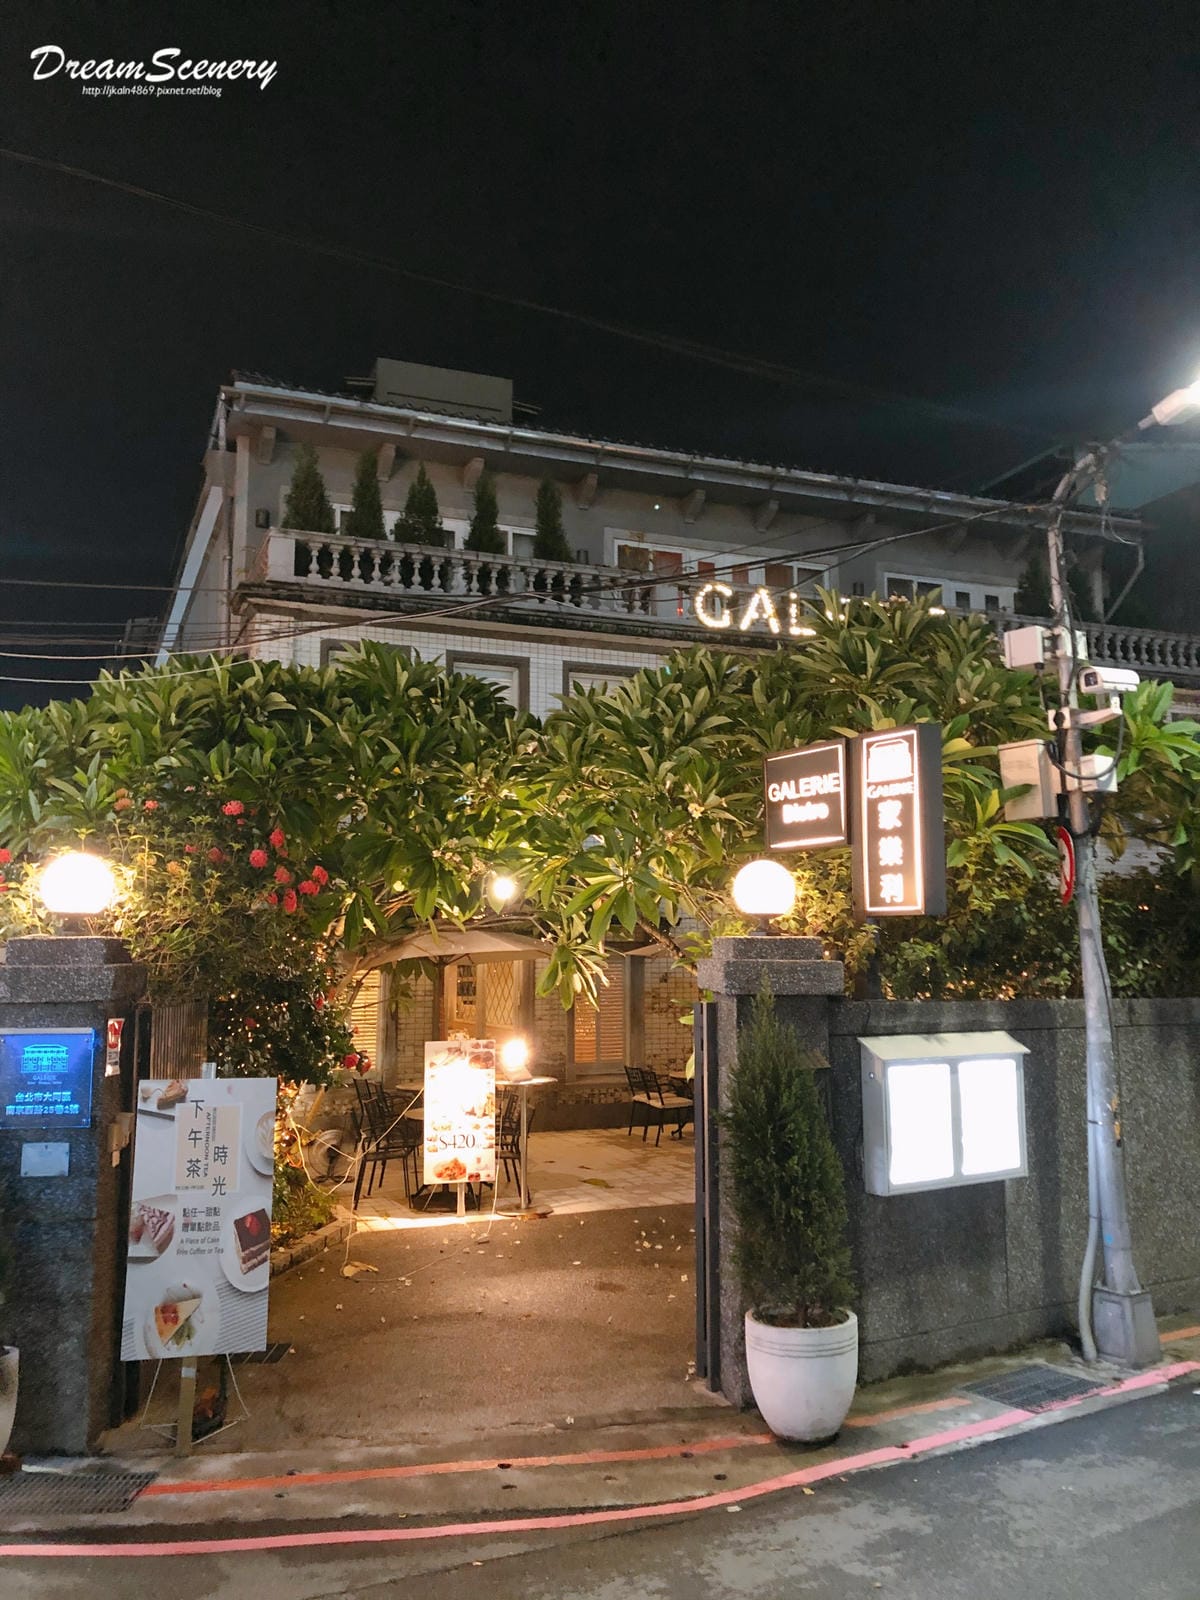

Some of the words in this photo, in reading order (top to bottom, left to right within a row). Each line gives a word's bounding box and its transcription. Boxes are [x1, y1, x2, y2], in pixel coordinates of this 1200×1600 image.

[694, 582, 850, 637] GAL
[767, 772, 841, 802] GALERIE
[866, 781, 914, 798] GALERIE
[186, 1099, 205, 1179] 下午茶
[204, 1112, 212, 1160] AFTERNOON
[212, 1144, 228, 1197] 時光
[182, 1206, 221, 1217] 點任一甜點
